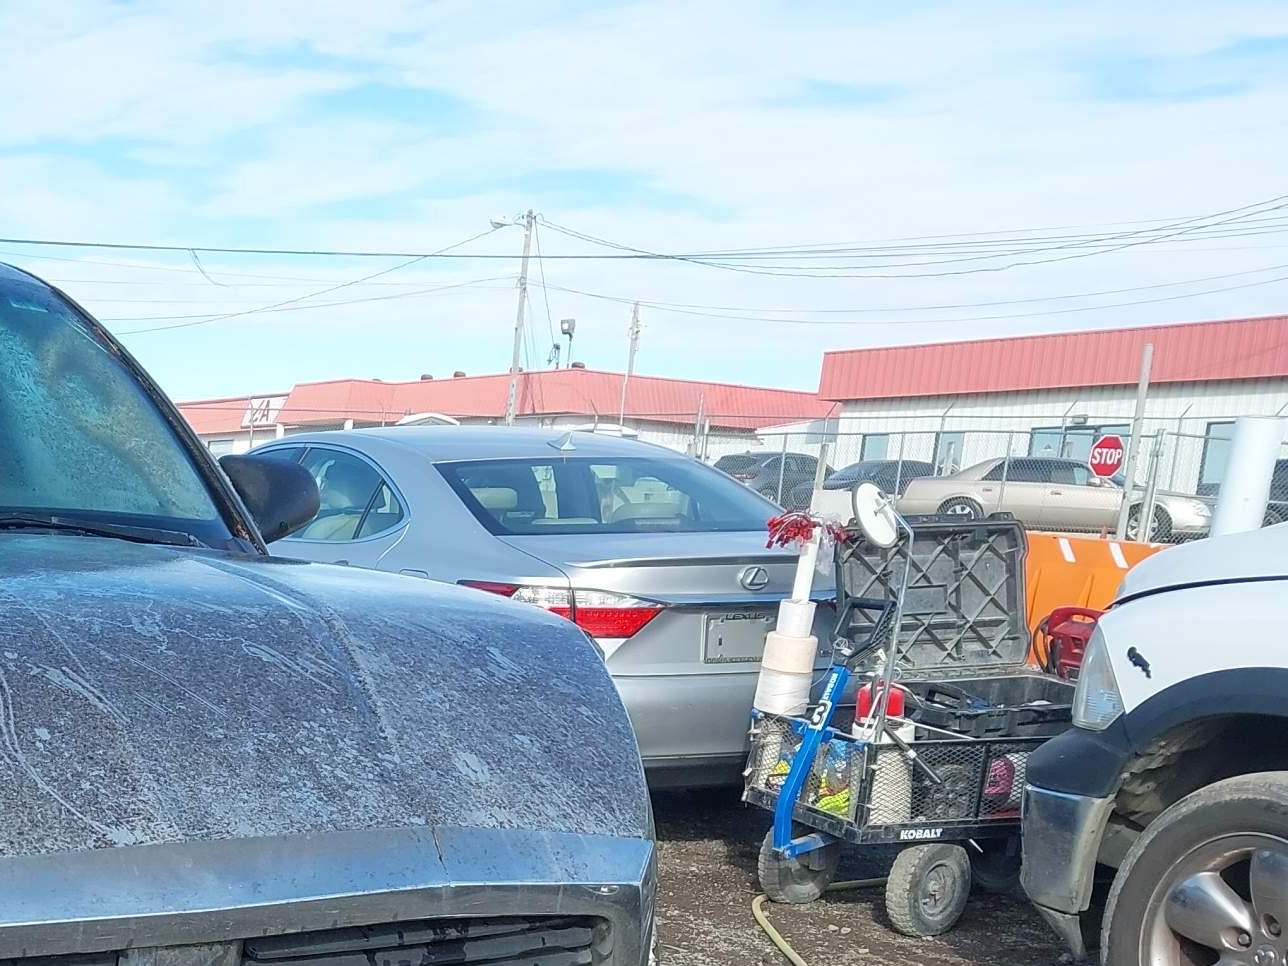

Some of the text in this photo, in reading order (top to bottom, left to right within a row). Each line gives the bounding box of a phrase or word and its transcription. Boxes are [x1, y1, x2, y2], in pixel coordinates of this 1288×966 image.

[1091, 447, 1123, 465] STOP
[725, 613, 766, 621] LEXUS
[811, 702, 828, 726] 3
[899, 828, 943, 840] KOBALT
